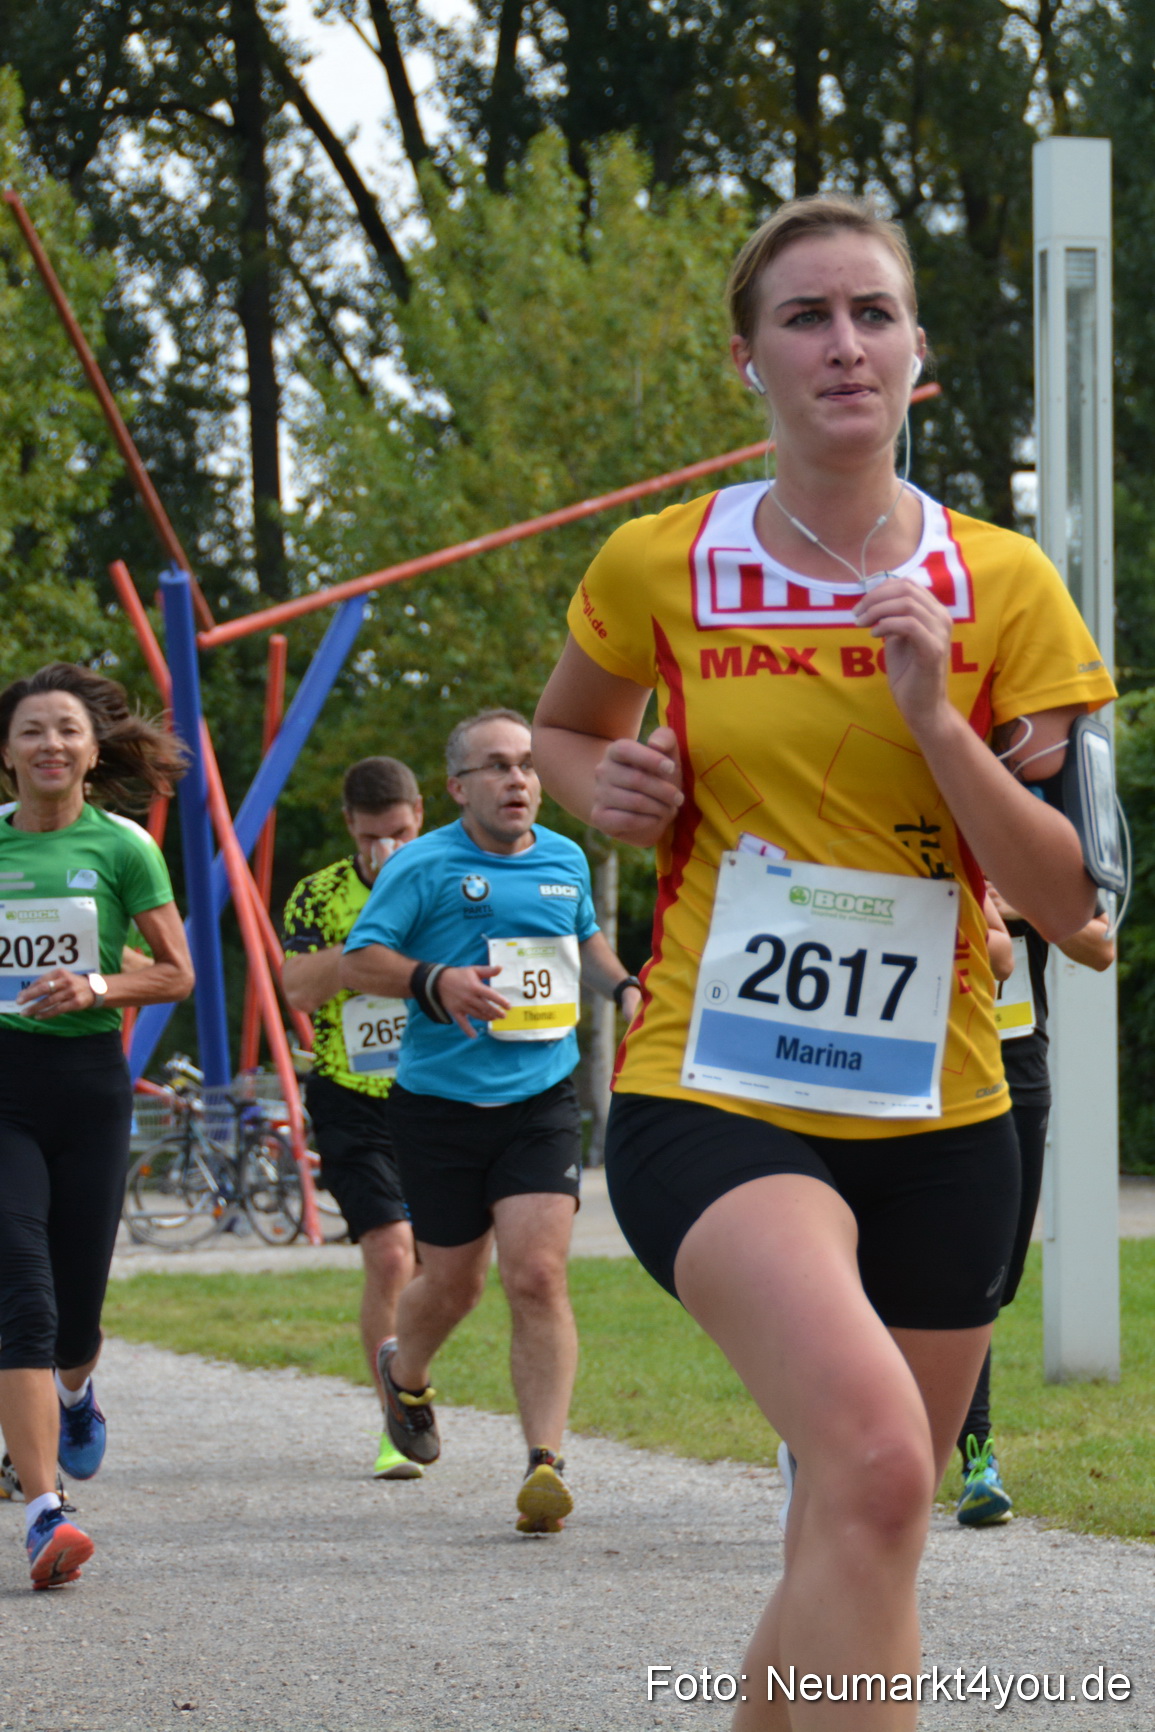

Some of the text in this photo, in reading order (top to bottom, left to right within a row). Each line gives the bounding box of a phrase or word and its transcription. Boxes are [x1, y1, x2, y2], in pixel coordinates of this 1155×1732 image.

[700, 637, 978, 679] MAX BL
[812, 889, 894, 918] BOCK
[0, 934, 79, 969] 2023
[522, 969, 551, 999] 59
[712, 986, 721, 999] D
[737, 933, 918, 1021] 2617
[776, 1035, 863, 1071] Marina
